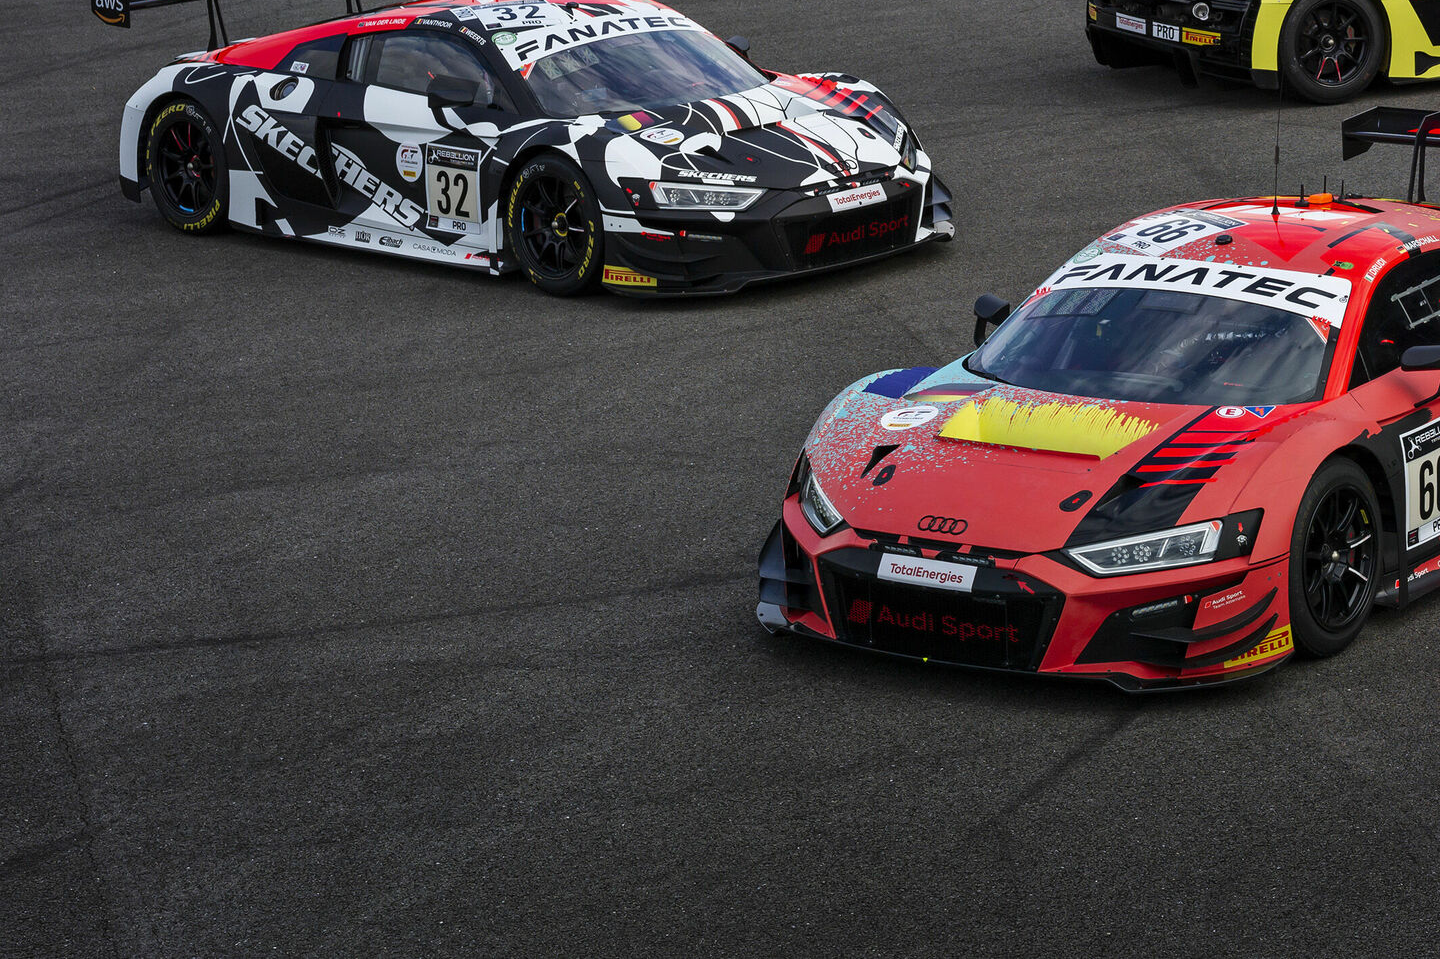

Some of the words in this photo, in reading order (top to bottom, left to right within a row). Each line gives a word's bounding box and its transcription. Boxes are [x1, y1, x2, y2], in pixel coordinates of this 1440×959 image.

[492, 5, 546, 21] 32
[422, 18, 453, 29] VANTHOOR
[1157, 24, 1175, 40] PRO
[465, 28, 487, 46] WEERTS
[515, 16, 692, 62] FANATEC
[236, 104, 426, 229] SKECHERS
[678, 169, 758, 183] SKECHERS
[436, 170, 470, 218] 32
[508, 175, 523, 228] PIRELLI
[834, 189, 881, 206] TotalEnergies
[184, 199, 221, 231] PIRELLI
[452, 221, 467, 231] PRO
[828, 224, 865, 247] Audi
[868, 214, 909, 238] Sport
[1136, 219, 1206, 244] 66
[1131, 241, 1151, 249] PRO
[1403, 235, 1440, 251] MARSCHALL
[1369, 257, 1388, 276] DRUDI
[604, 268, 651, 284] PIRELLI
[1052, 263, 1339, 310] FANATEC
[890, 562, 964, 584] TotalEnergies
[1414, 568, 1430, 579] Sport
[1211, 595, 1226, 606] Audi
[1226, 590, 1243, 601] Sport
[877, 603, 934, 633] Audi
[941, 614, 1020, 643] Sport
